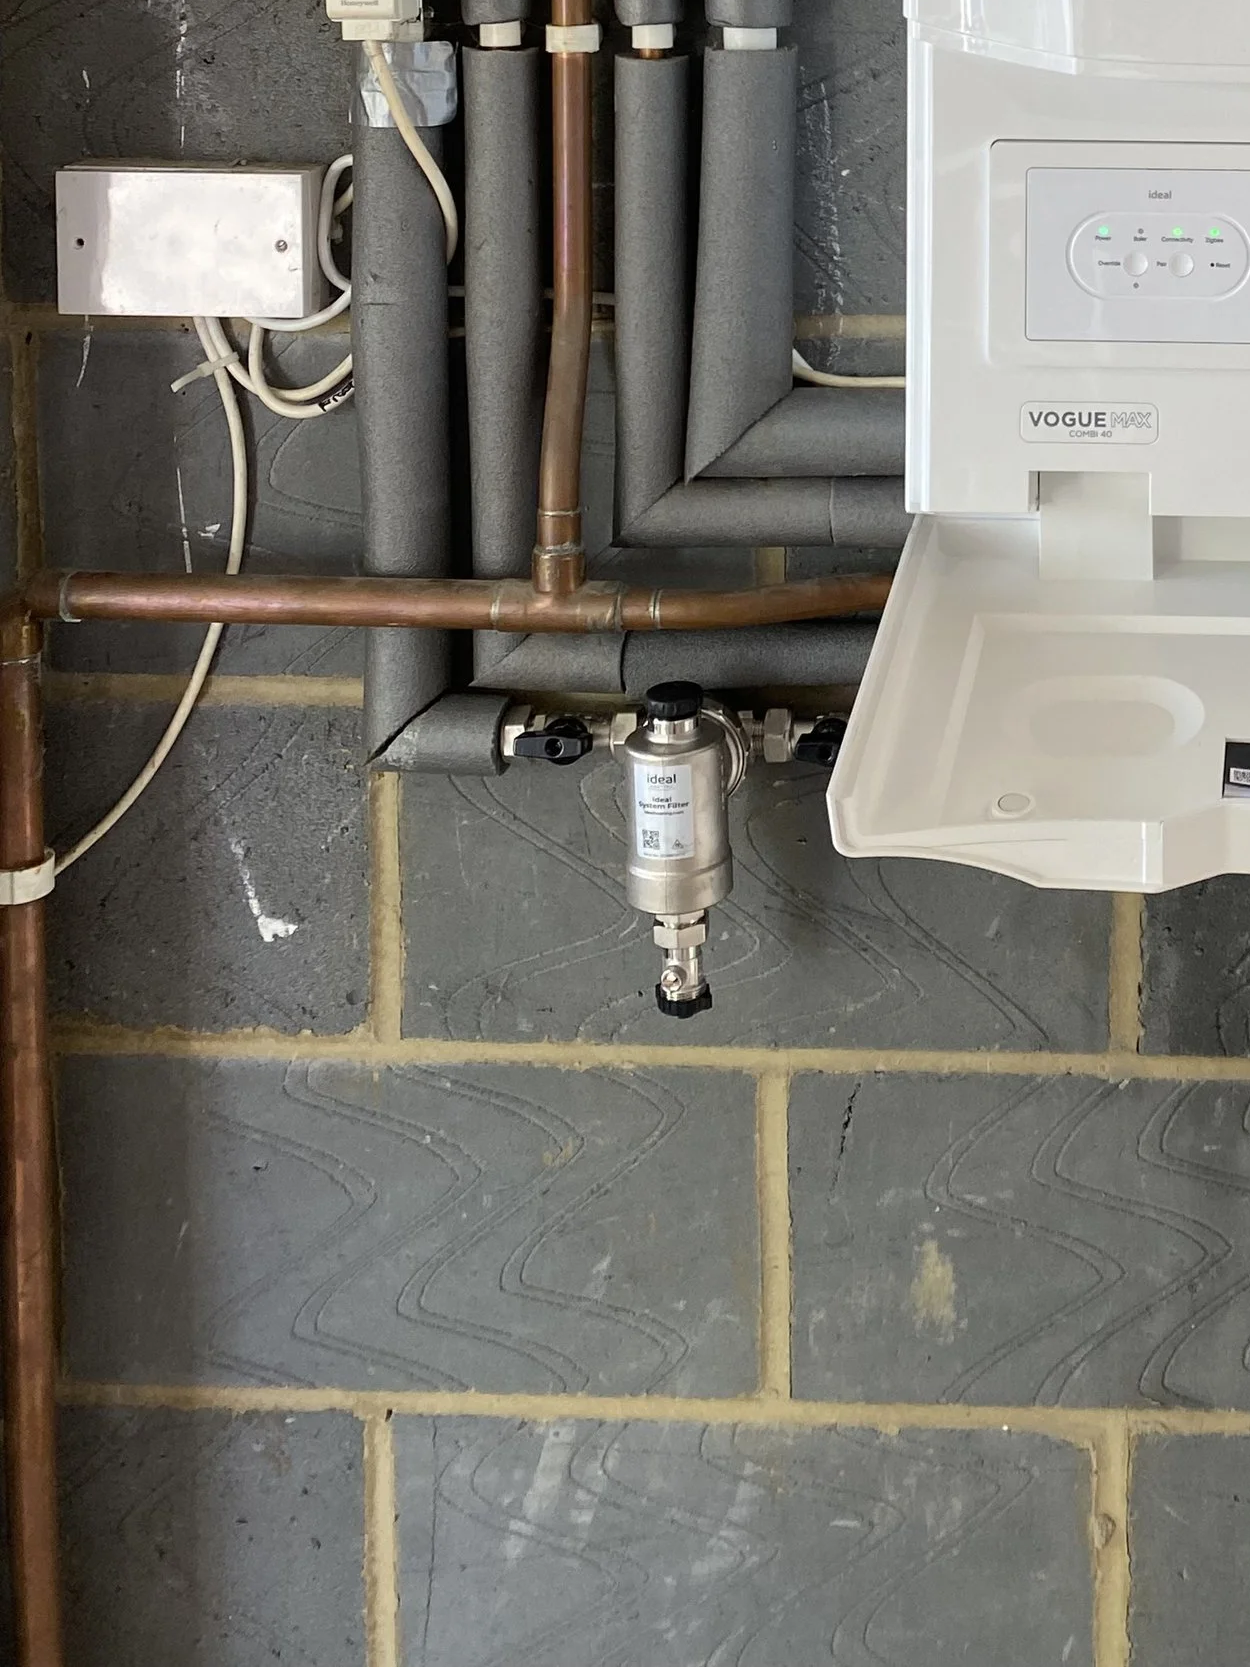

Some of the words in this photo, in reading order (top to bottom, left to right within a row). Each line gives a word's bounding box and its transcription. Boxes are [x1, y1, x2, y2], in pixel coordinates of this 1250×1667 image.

[1148, 190, 1173, 200] ideal
[1028, 411, 1107, 428] VOGUE
[1110, 412, 1152, 429] MAX
[1068, 430, 1099, 438] COMBI
[1101, 430, 1113, 438] 40
[647, 773, 677, 784] ideal
[638, 800, 666, 809] System
[667, 801, 690, 809] Filter
